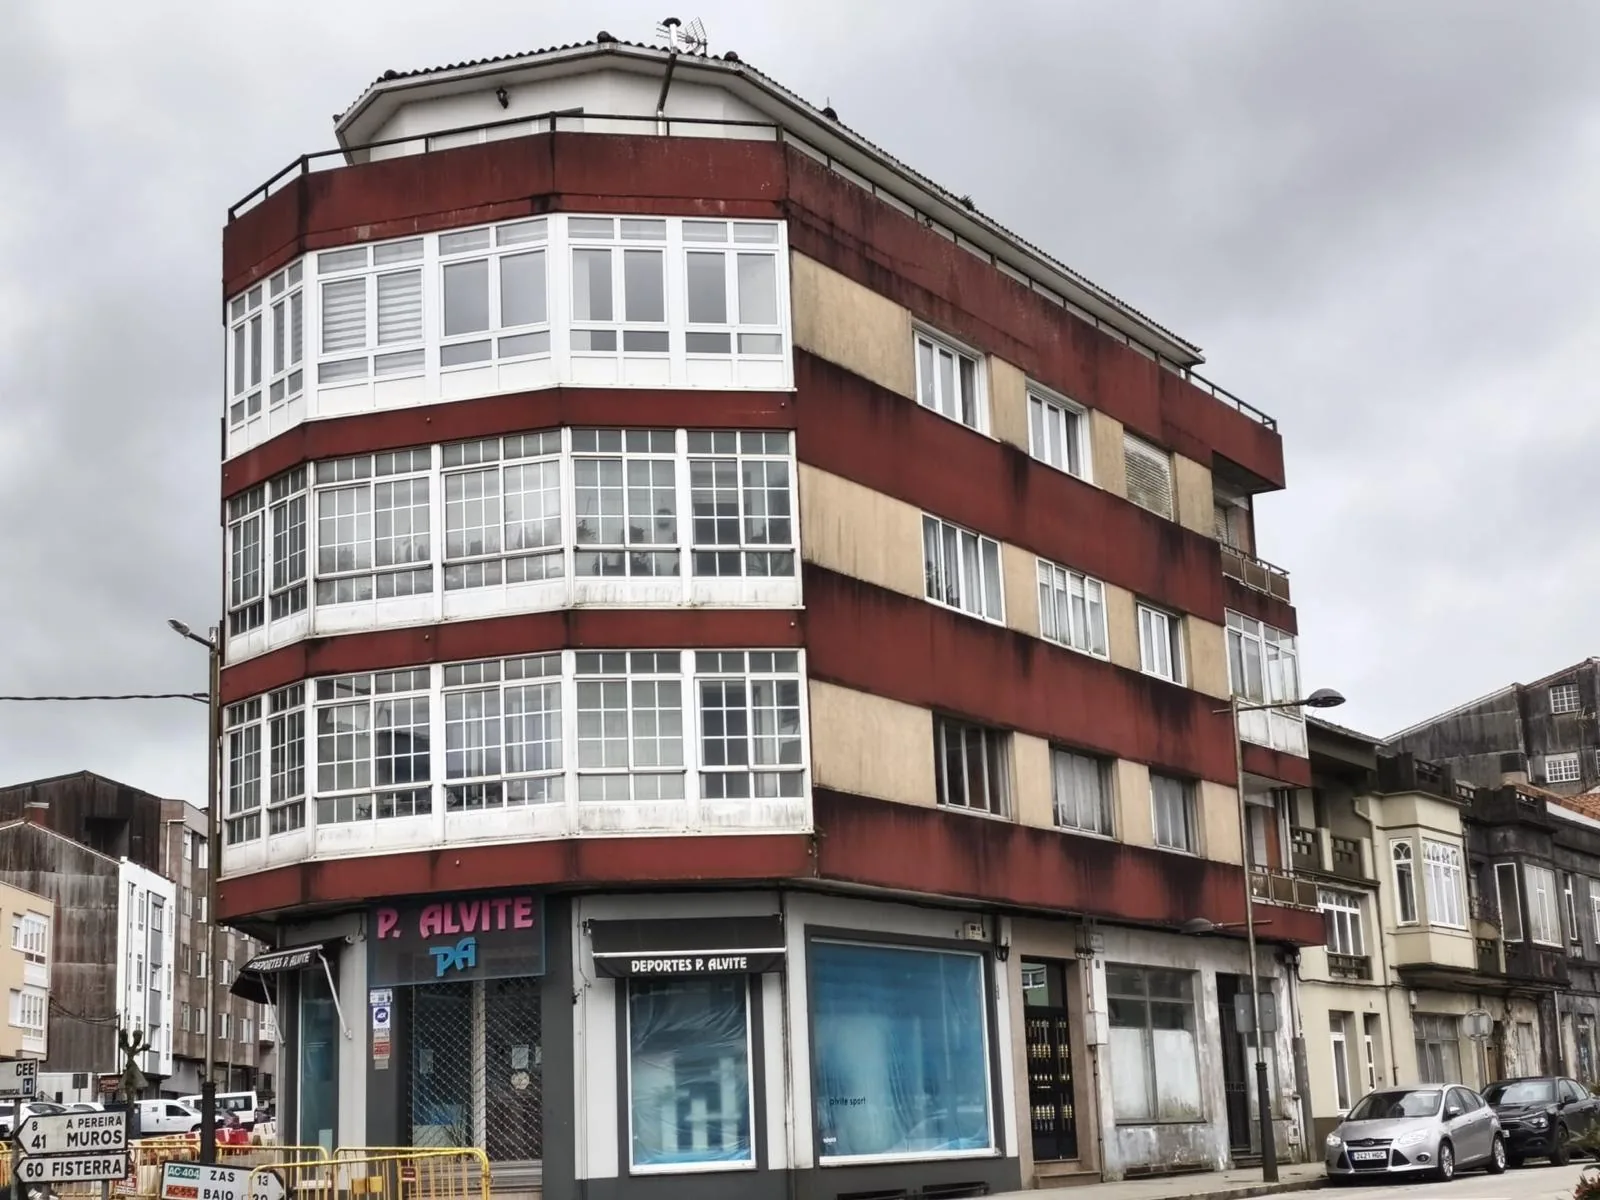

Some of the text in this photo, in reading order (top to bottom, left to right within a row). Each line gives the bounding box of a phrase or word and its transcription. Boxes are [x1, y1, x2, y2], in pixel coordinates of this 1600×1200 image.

[376, 897, 534, 939] P. ALVITE
[248, 957, 283, 971] DEPORTES
[290, 952, 311, 967] ALVITE
[429, 936, 477, 977] PA
[631, 957, 748, 973] DEPORTES P. ALVITE
[16, 1063, 35, 1077] CEE
[32, 1116, 123, 1131] 8 A PEREIRA
[31, 1130, 122, 1149] 41 MUROS
[26, 1159, 122, 1178] 60 FISTERRA
[210, 1170, 268, 1186] ZAS 13
